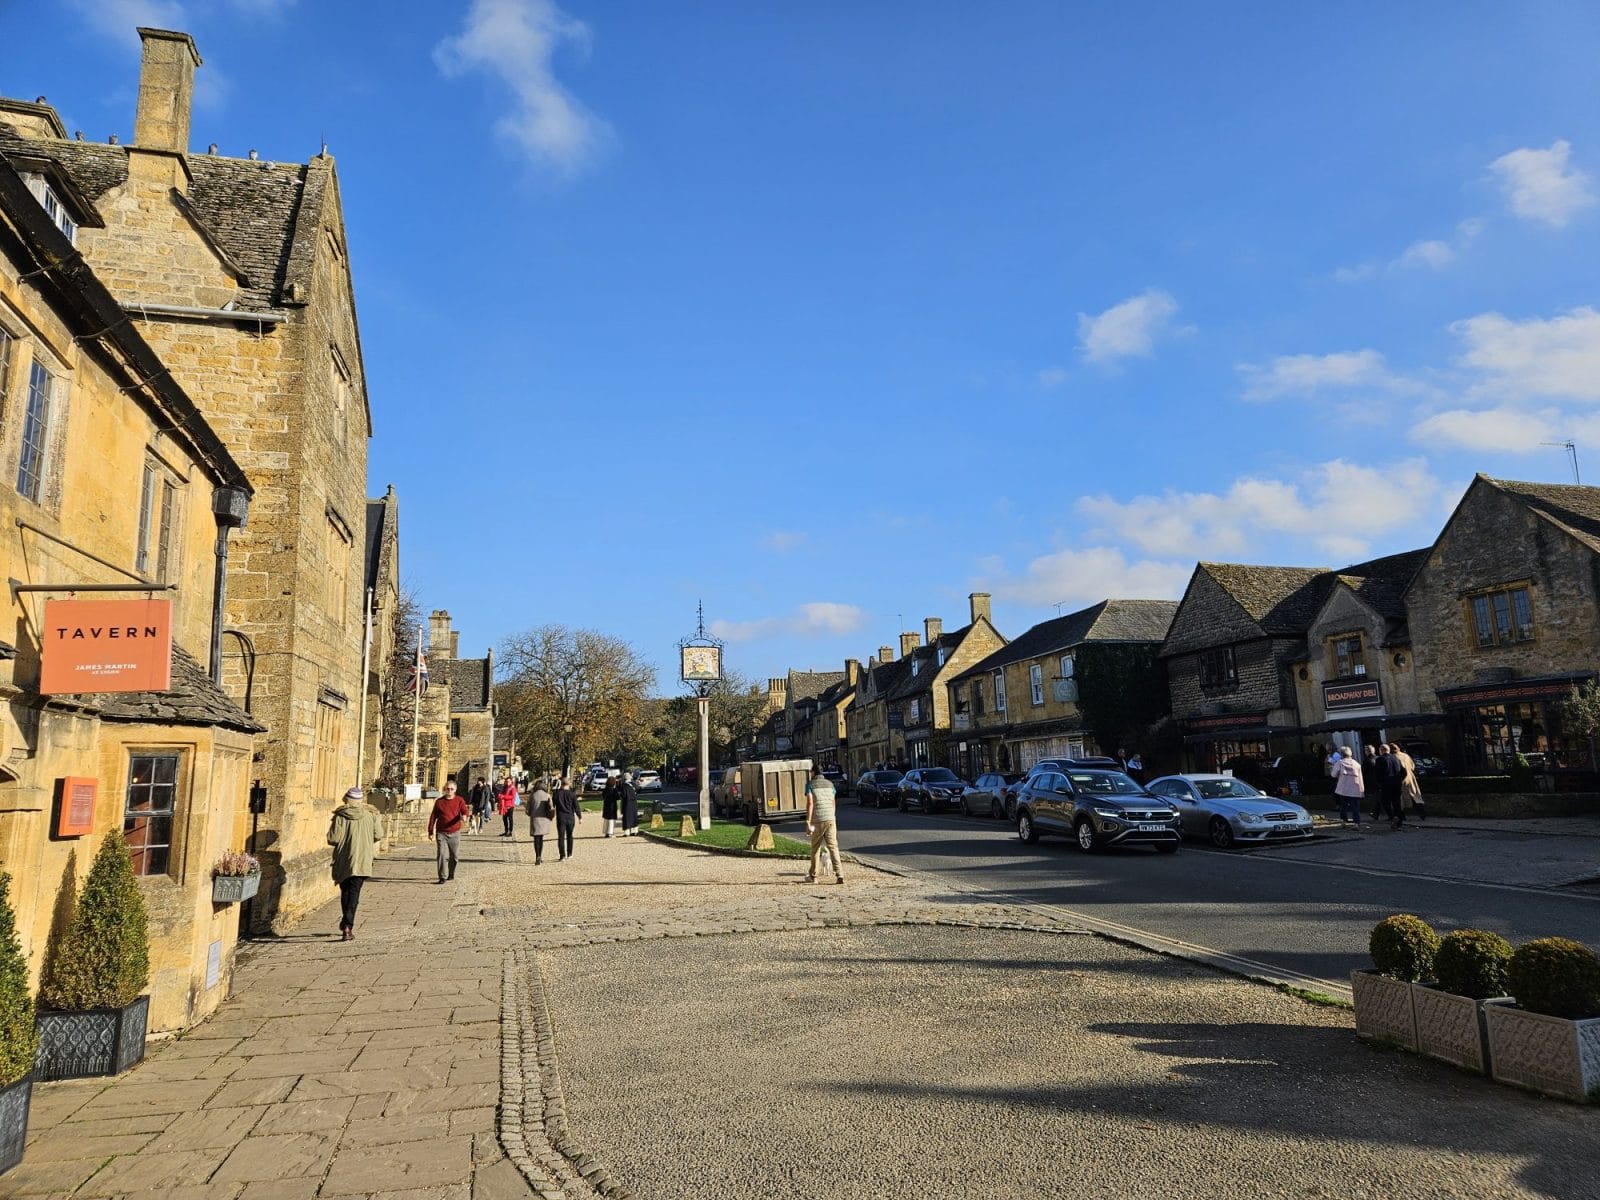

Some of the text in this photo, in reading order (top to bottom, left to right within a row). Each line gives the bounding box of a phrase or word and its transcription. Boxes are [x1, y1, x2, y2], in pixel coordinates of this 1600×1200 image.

[57, 626, 156, 639] TAVERN
[1327, 689, 1377, 701] BROADWAY DELI
